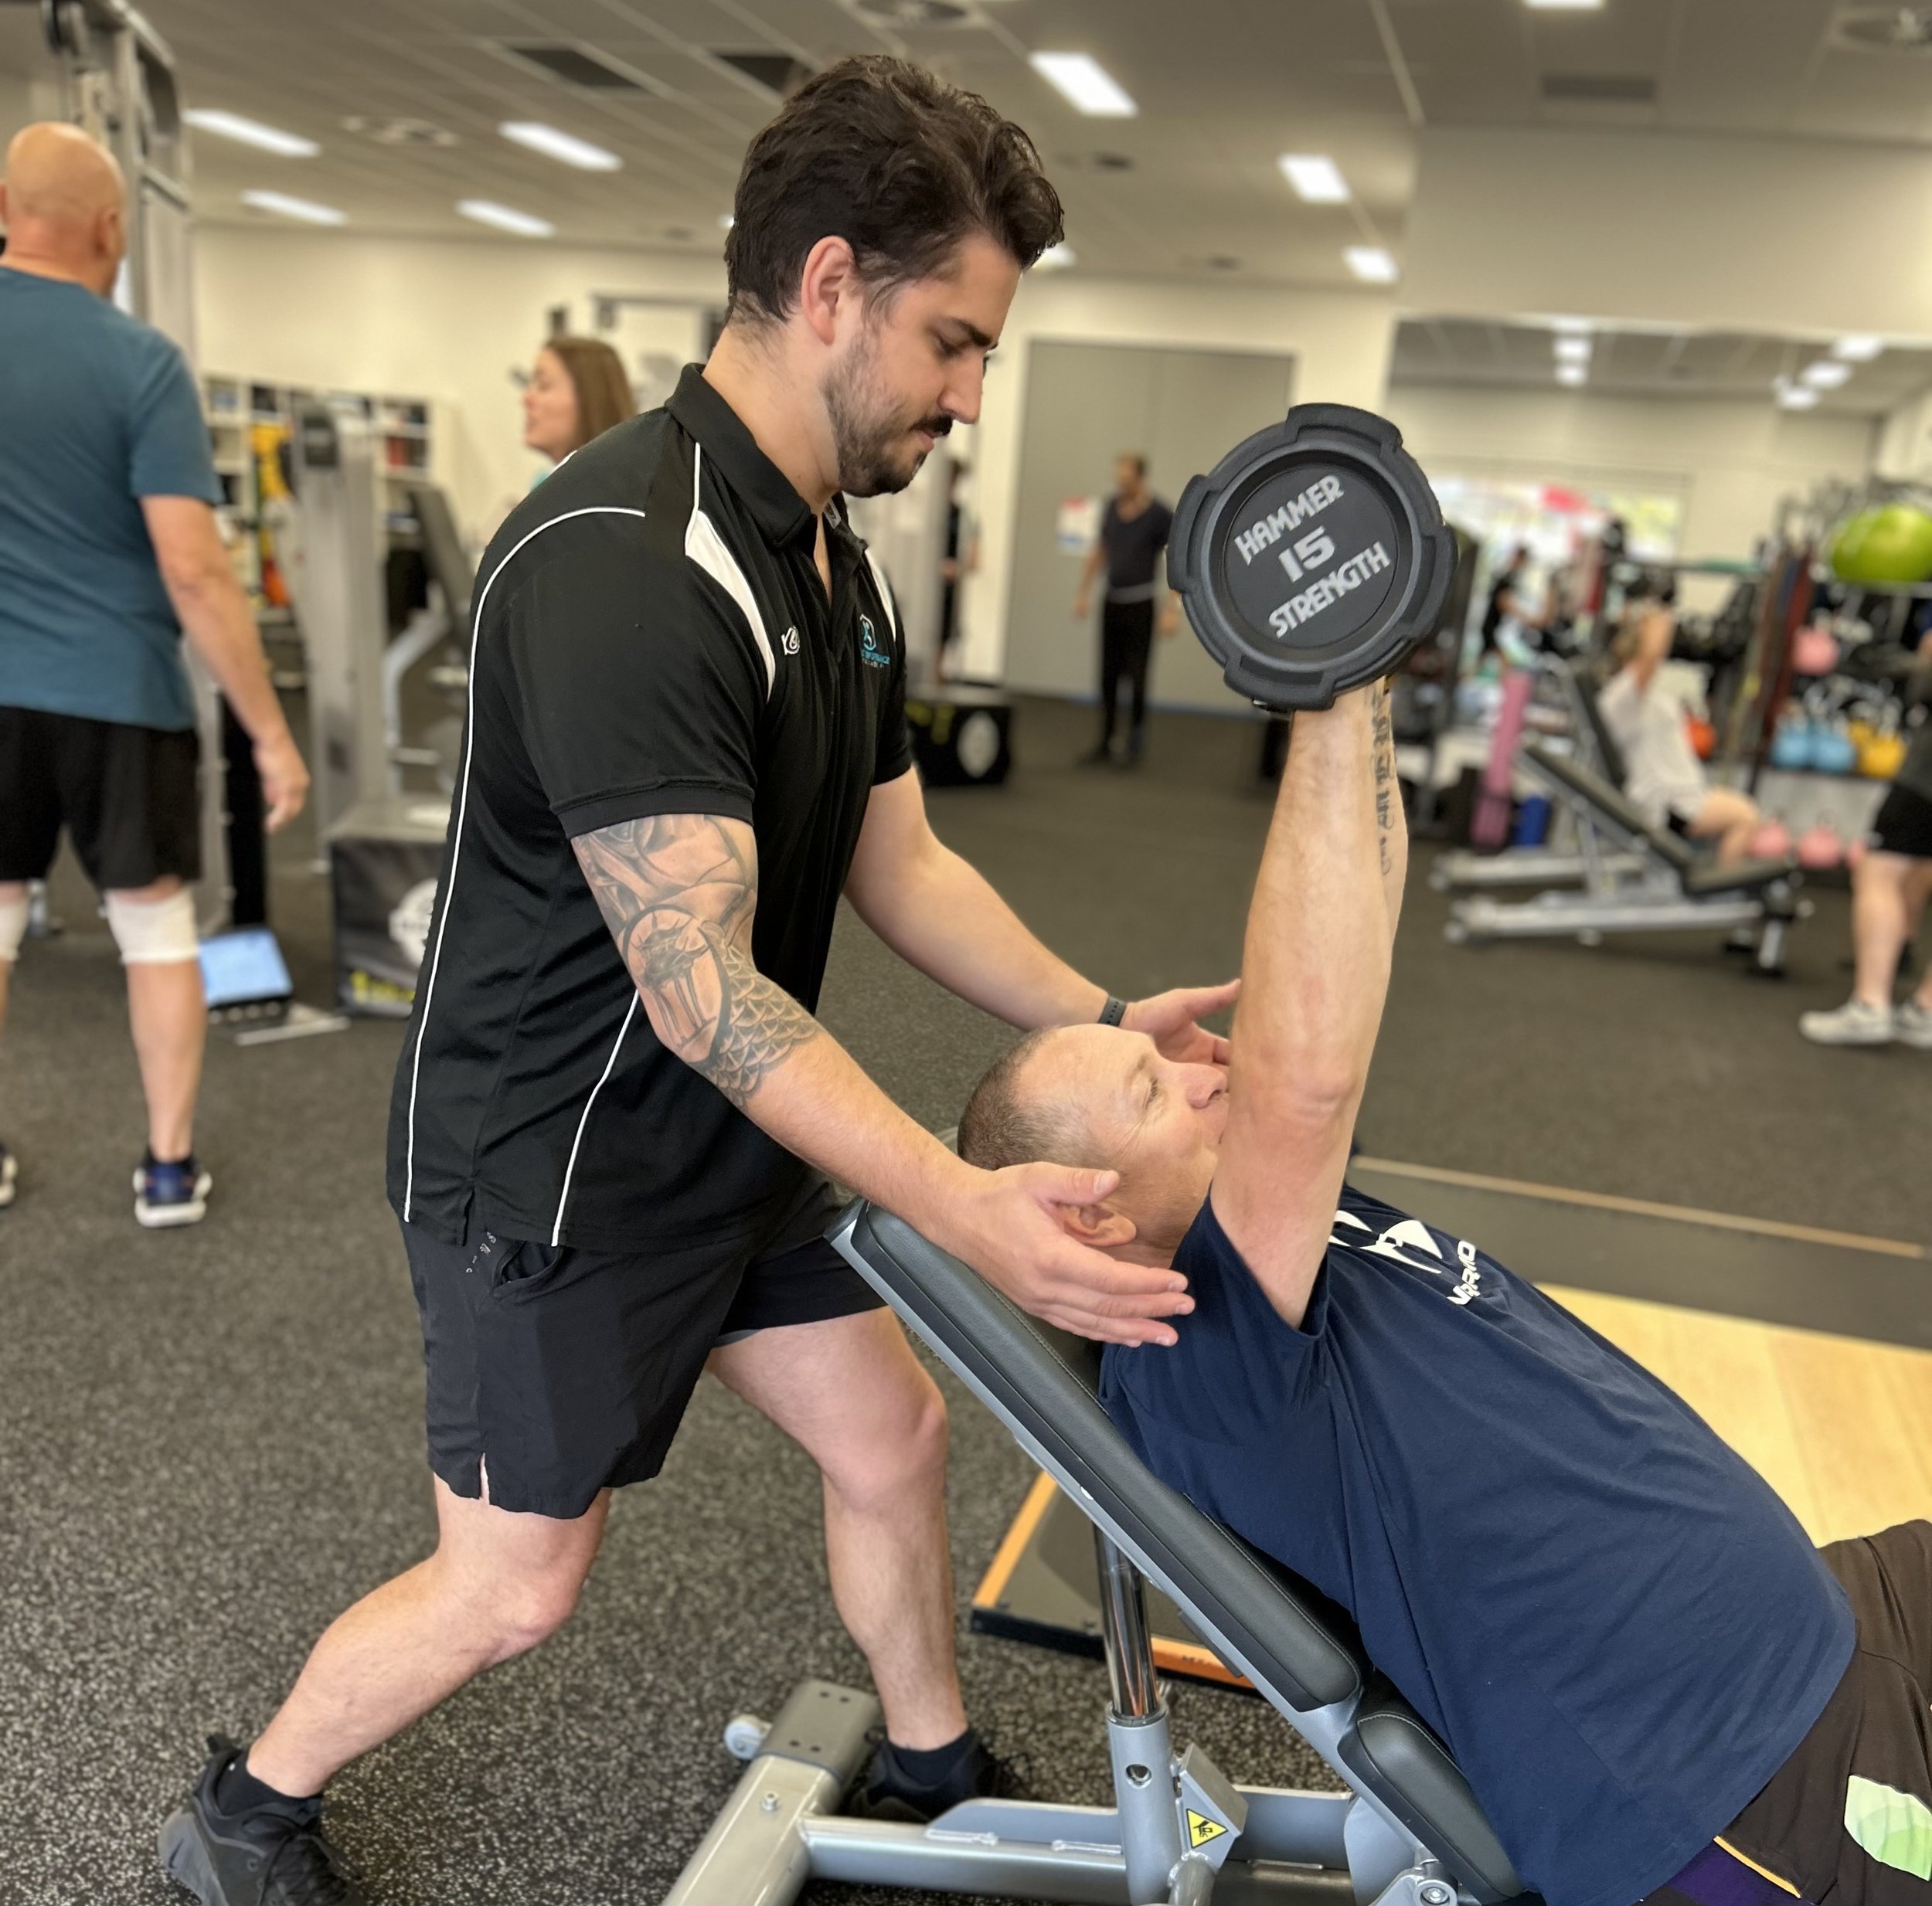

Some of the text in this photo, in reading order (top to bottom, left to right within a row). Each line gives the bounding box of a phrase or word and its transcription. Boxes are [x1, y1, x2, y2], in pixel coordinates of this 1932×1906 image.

[1234, 475, 1345, 566] HAMMER
[1278, 525, 1335, 583] 15
[1268, 541, 1391, 639] STRENGTH
